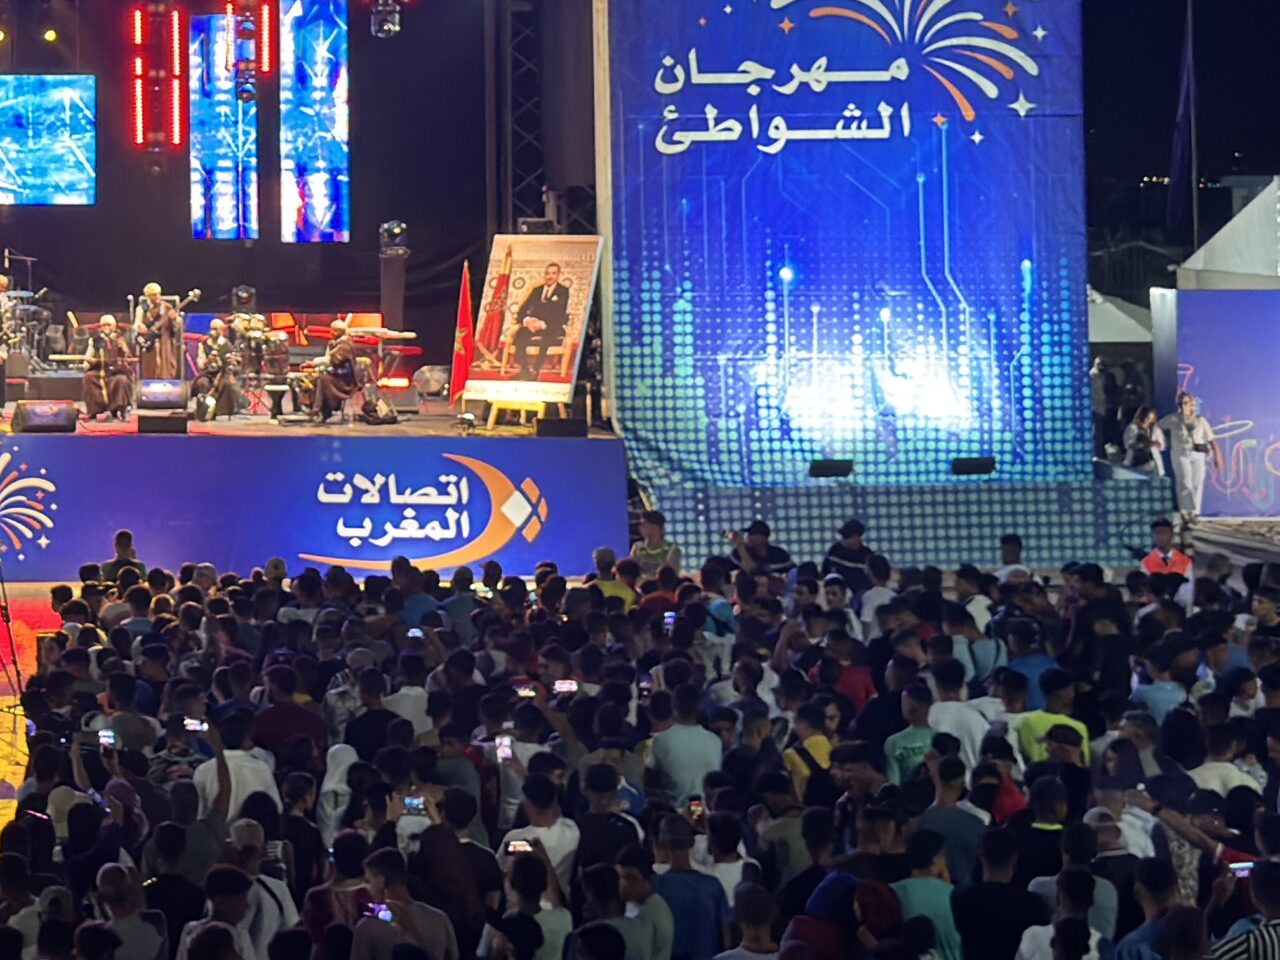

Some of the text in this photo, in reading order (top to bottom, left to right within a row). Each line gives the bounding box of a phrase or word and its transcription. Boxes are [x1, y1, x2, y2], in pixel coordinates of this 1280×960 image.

[654, 48, 909, 95] مهرجان
[654, 101, 910, 155] الشواطئ
[316, 471, 469, 506] اتصالات
[336, 507, 470, 546] المغرب
